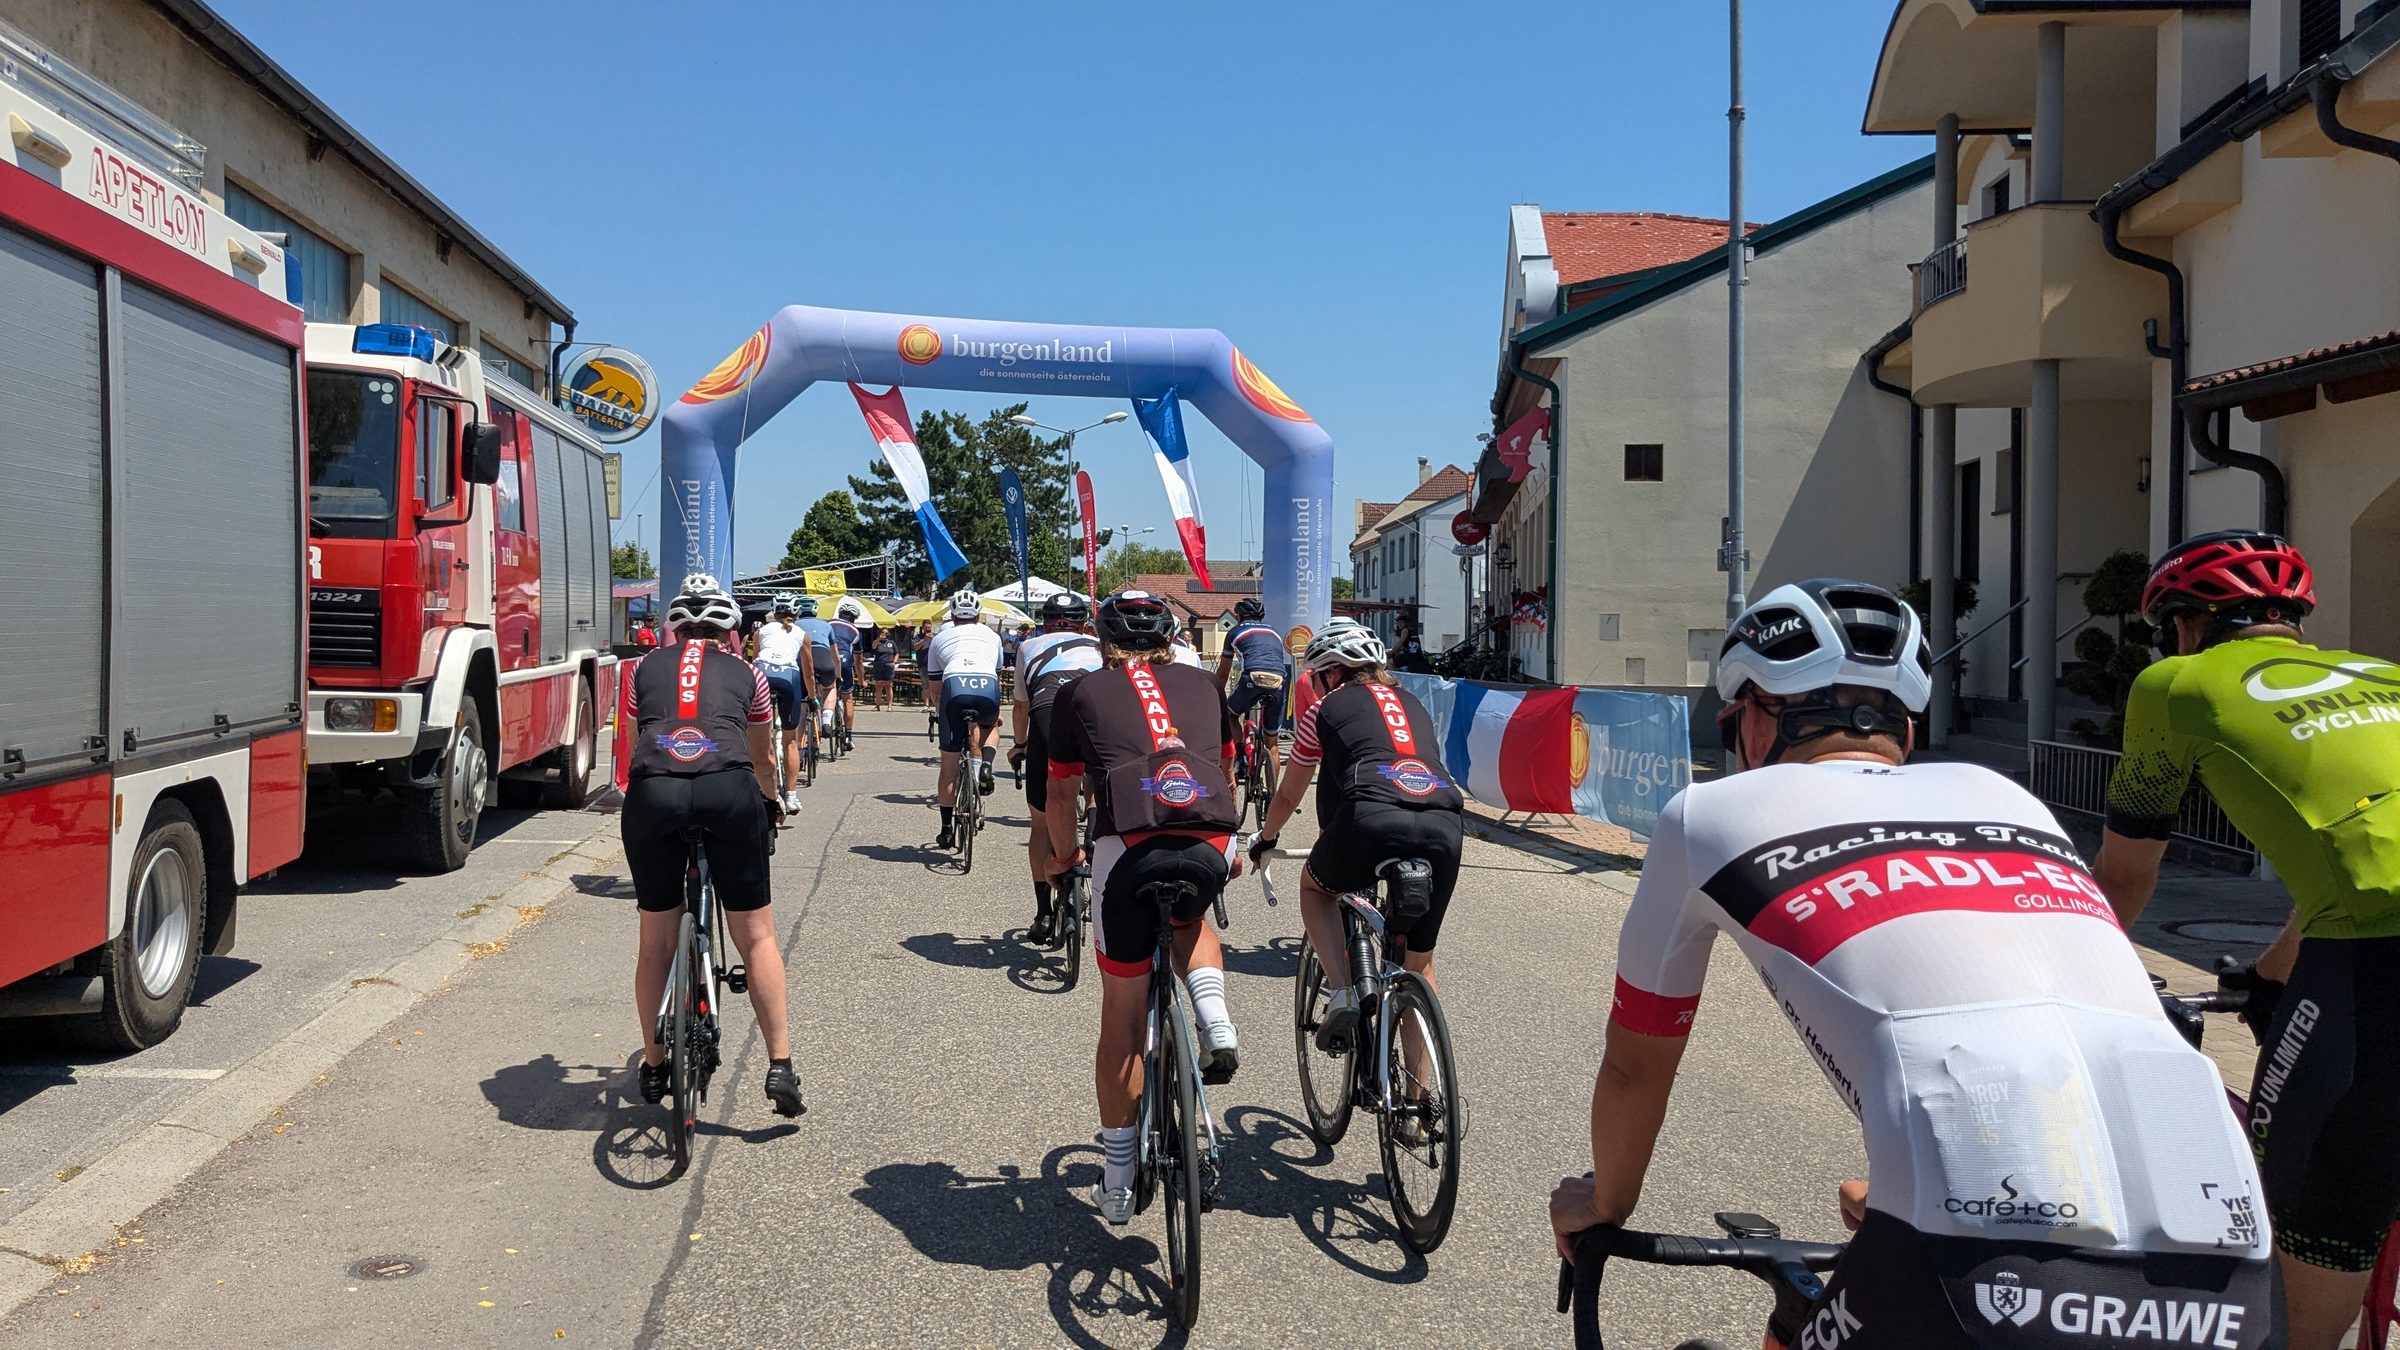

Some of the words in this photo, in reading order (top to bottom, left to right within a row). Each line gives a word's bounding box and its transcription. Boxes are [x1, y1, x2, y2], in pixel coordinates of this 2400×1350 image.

[89, 146, 207, 256] APETLON
[952, 333, 1113, 366] burgenland
[979, 368, 995, 378] die
[997, 369, 1055, 380] sonnenseite
[1057, 370, 1112, 382] österreichs
[575, 405, 625, 430] BATTERIE
[1292, 497, 1314, 619] burgenland
[1758, 617, 1803, 645] KASK
[958, 676, 989, 690] YCP
[1753, 827, 1966, 880] Racing
[1974, 825, 2093, 875] Team
[1804, 1025, 1853, 1097] Herbert
[2259, 998, 2321, 1104] UNLIMITED
[1995, 1218, 2078, 1229] cafeplusco.com
[2049, 1292, 2245, 1350] GRAWE
